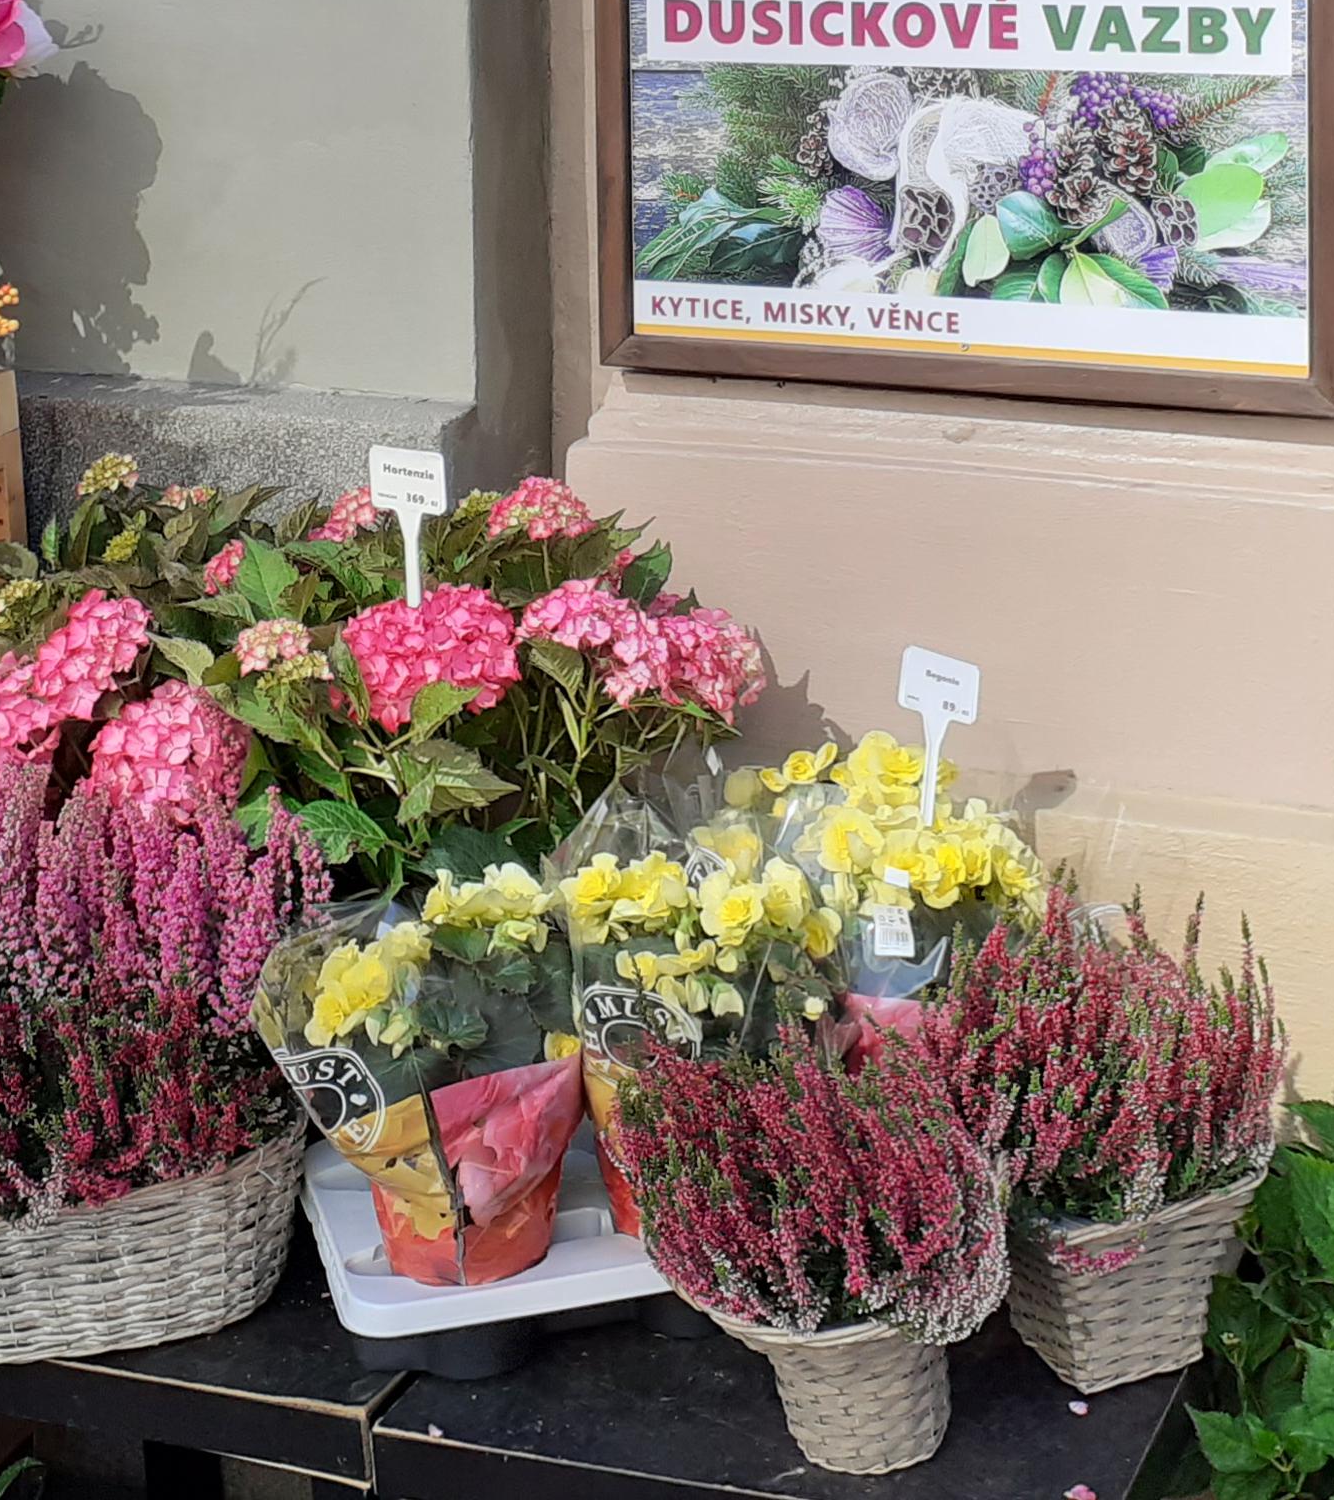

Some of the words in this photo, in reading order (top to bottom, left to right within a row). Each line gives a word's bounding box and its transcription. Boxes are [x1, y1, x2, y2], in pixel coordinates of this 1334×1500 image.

[1043, 4, 1276, 56] VAZBY
[651, 295, 751, 325] KYTICE,
[764, 301, 856, 331] MISKY,
[868, 302, 961, 334] VĚNCE
[383, 463, 435, 480] Hortenzie
[286, 1059, 363, 1087] UST
